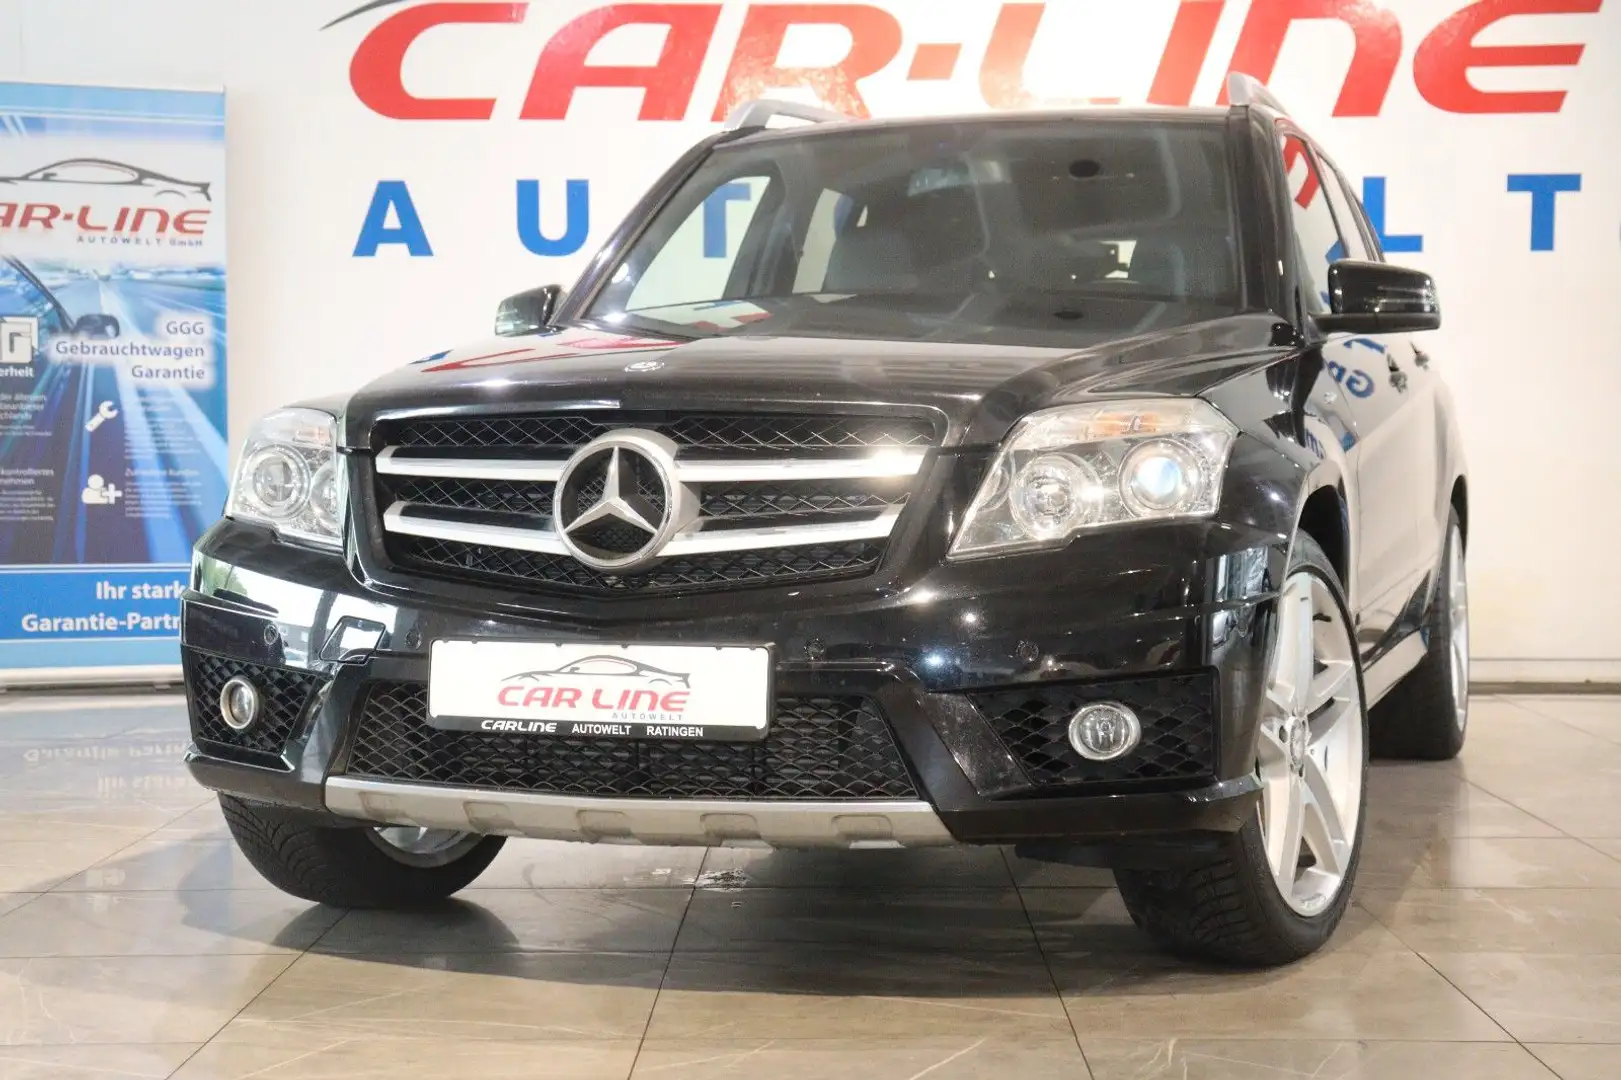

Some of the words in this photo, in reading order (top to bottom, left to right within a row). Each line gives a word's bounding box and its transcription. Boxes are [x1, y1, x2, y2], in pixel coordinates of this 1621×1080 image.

[349, 0, 1603, 122] CAR-LINE
[77, 235, 162, 247] AUTOWELT
[166, 321, 205, 336] GGG
[56, 340, 205, 360] Gebrauchtwagen
[131, 362, 206, 381] Garantie
[95, 580, 127, 600] Ihr
[497, 685, 583, 709] CAR
[591, 688, 691, 713] LINE
[612, 712, 684, 722] AUTOWELT
[480, 718, 558, 734] CARLINE
[571, 723, 632, 736] AUTOWELT
[646, 725, 704, 738] RATINGEN
